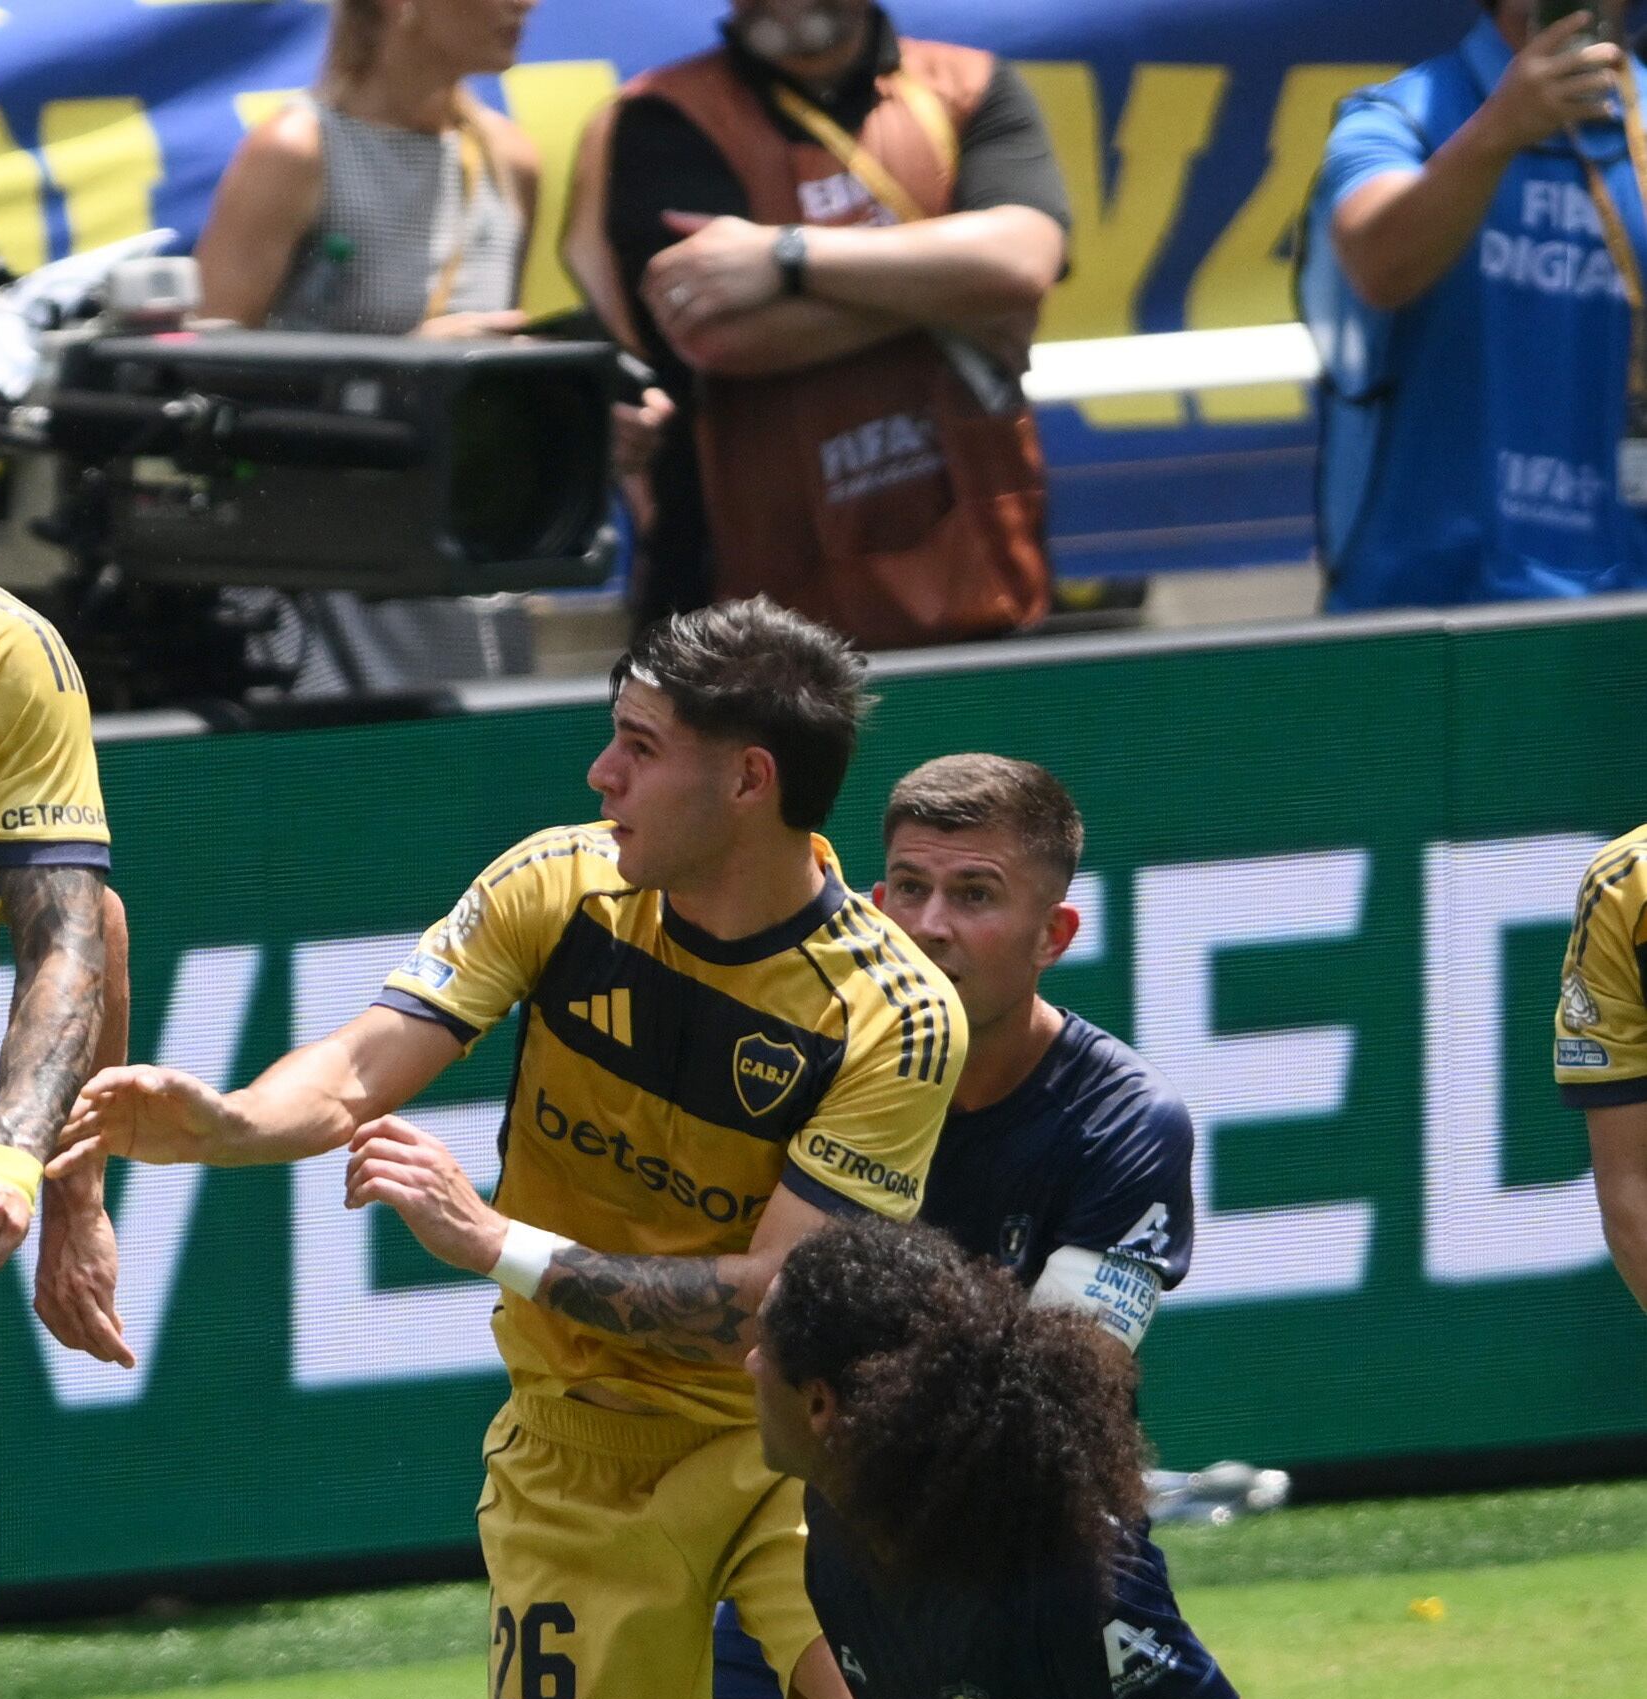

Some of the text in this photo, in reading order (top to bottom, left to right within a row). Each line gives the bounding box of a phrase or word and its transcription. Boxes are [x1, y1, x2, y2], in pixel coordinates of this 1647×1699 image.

[0, 801, 105, 831] CETROGA
[738, 1056, 792, 1088] CABJ
[807, 1133, 920, 1202] CETROGAR
[1095, 1264, 1156, 1313] UNITES
